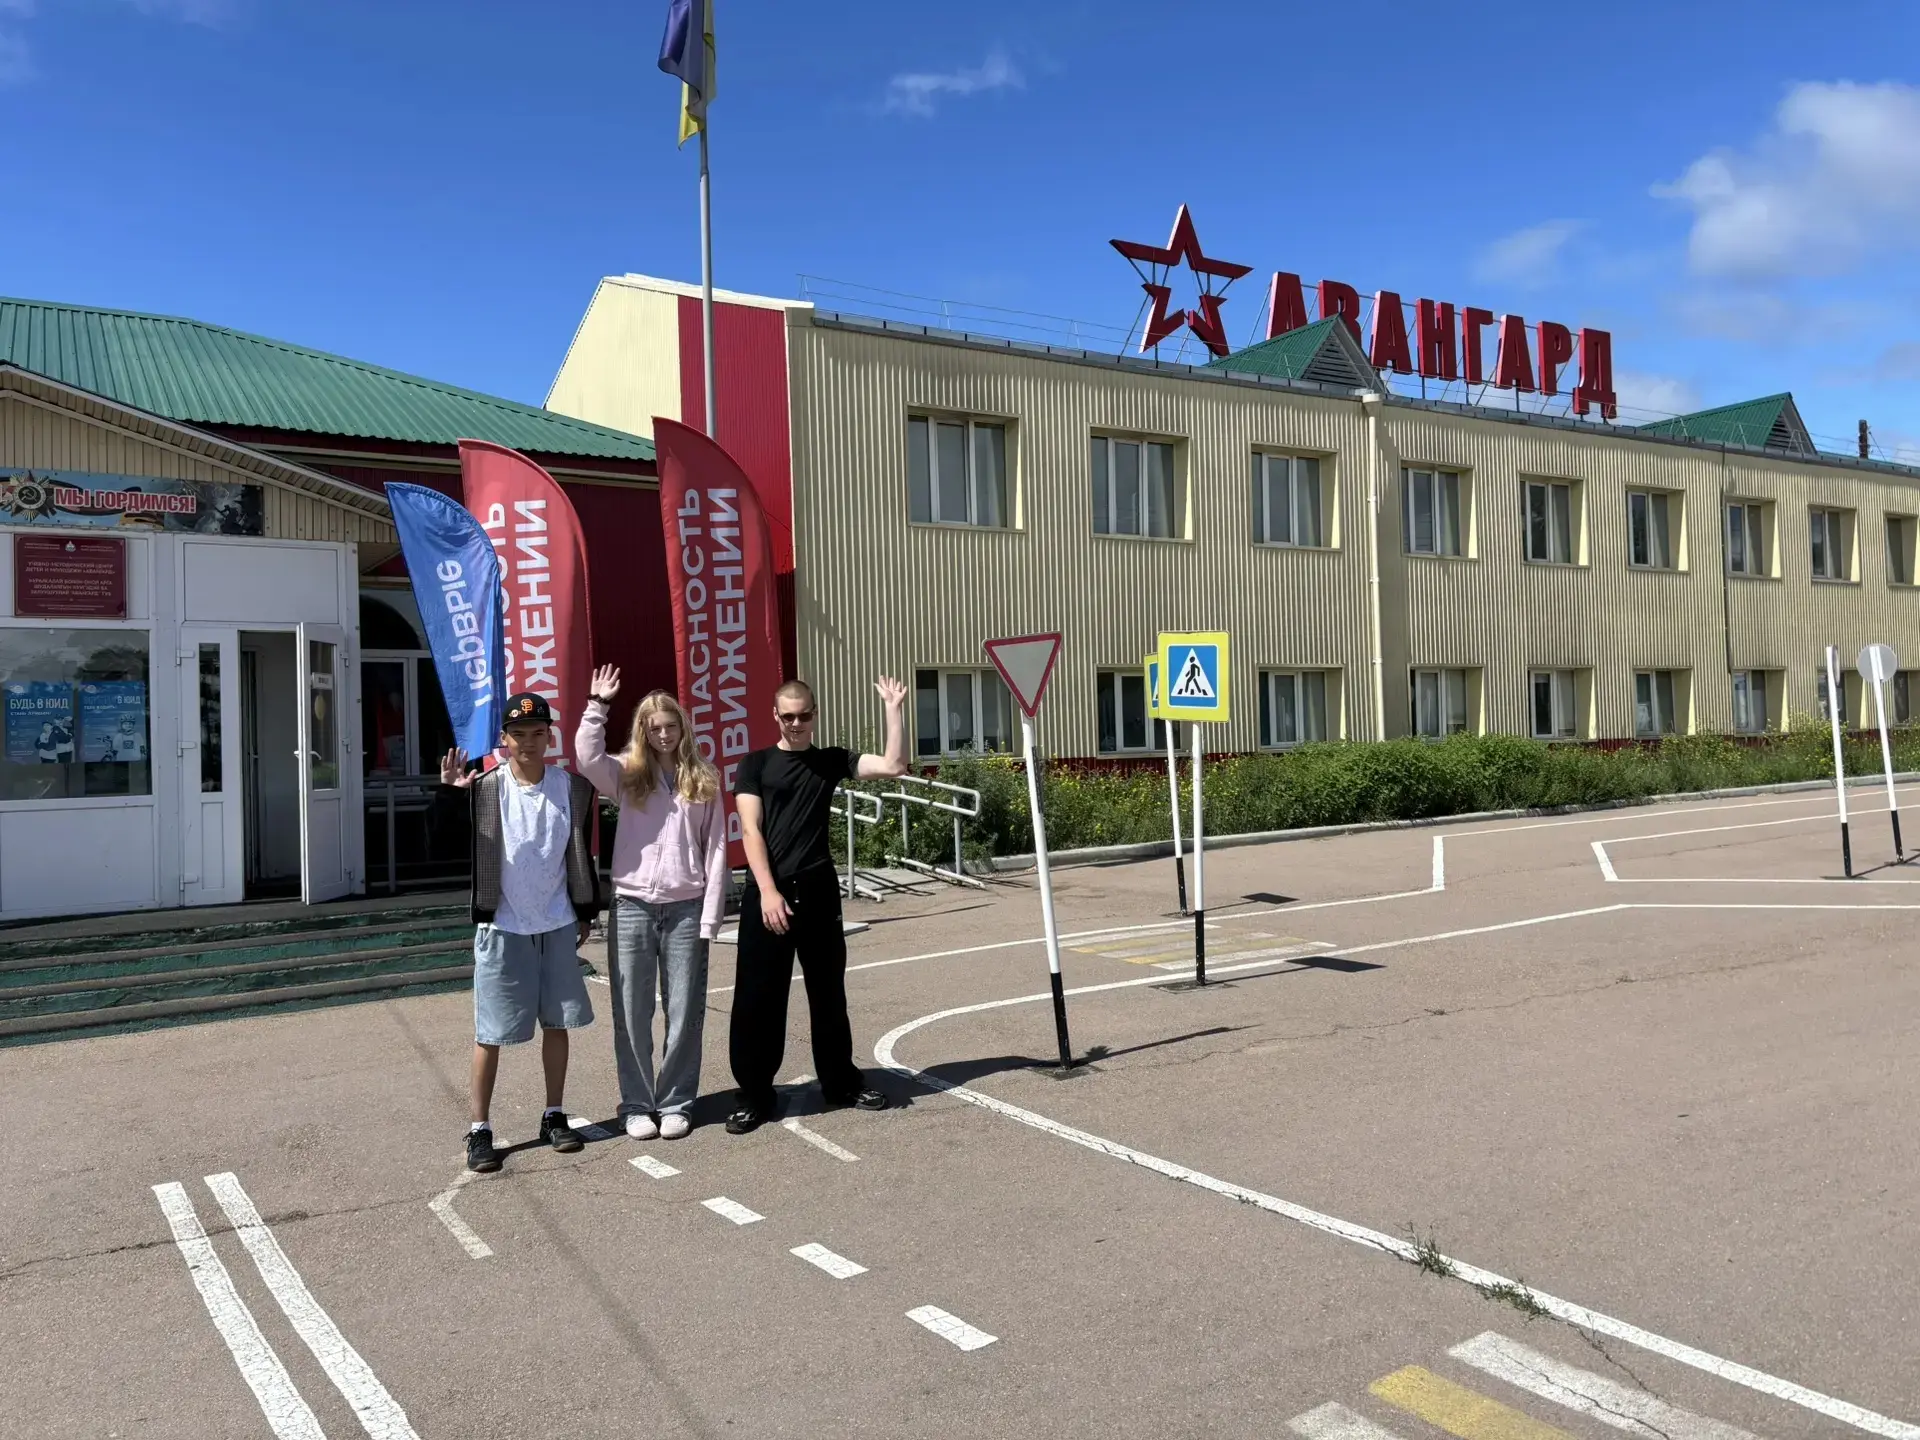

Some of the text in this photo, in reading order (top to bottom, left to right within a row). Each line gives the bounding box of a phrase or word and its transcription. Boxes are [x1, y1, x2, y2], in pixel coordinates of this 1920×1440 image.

[1265, 271, 1618, 420] АВАНГАРД
[54, 487, 197, 514] МЫ ГОРДИМСЯ!
[677, 488, 717, 764] ОПАСНОСТЬ
[10, 698, 35, 710] БУДЬ
[46, 698, 69, 709] ЮИД
